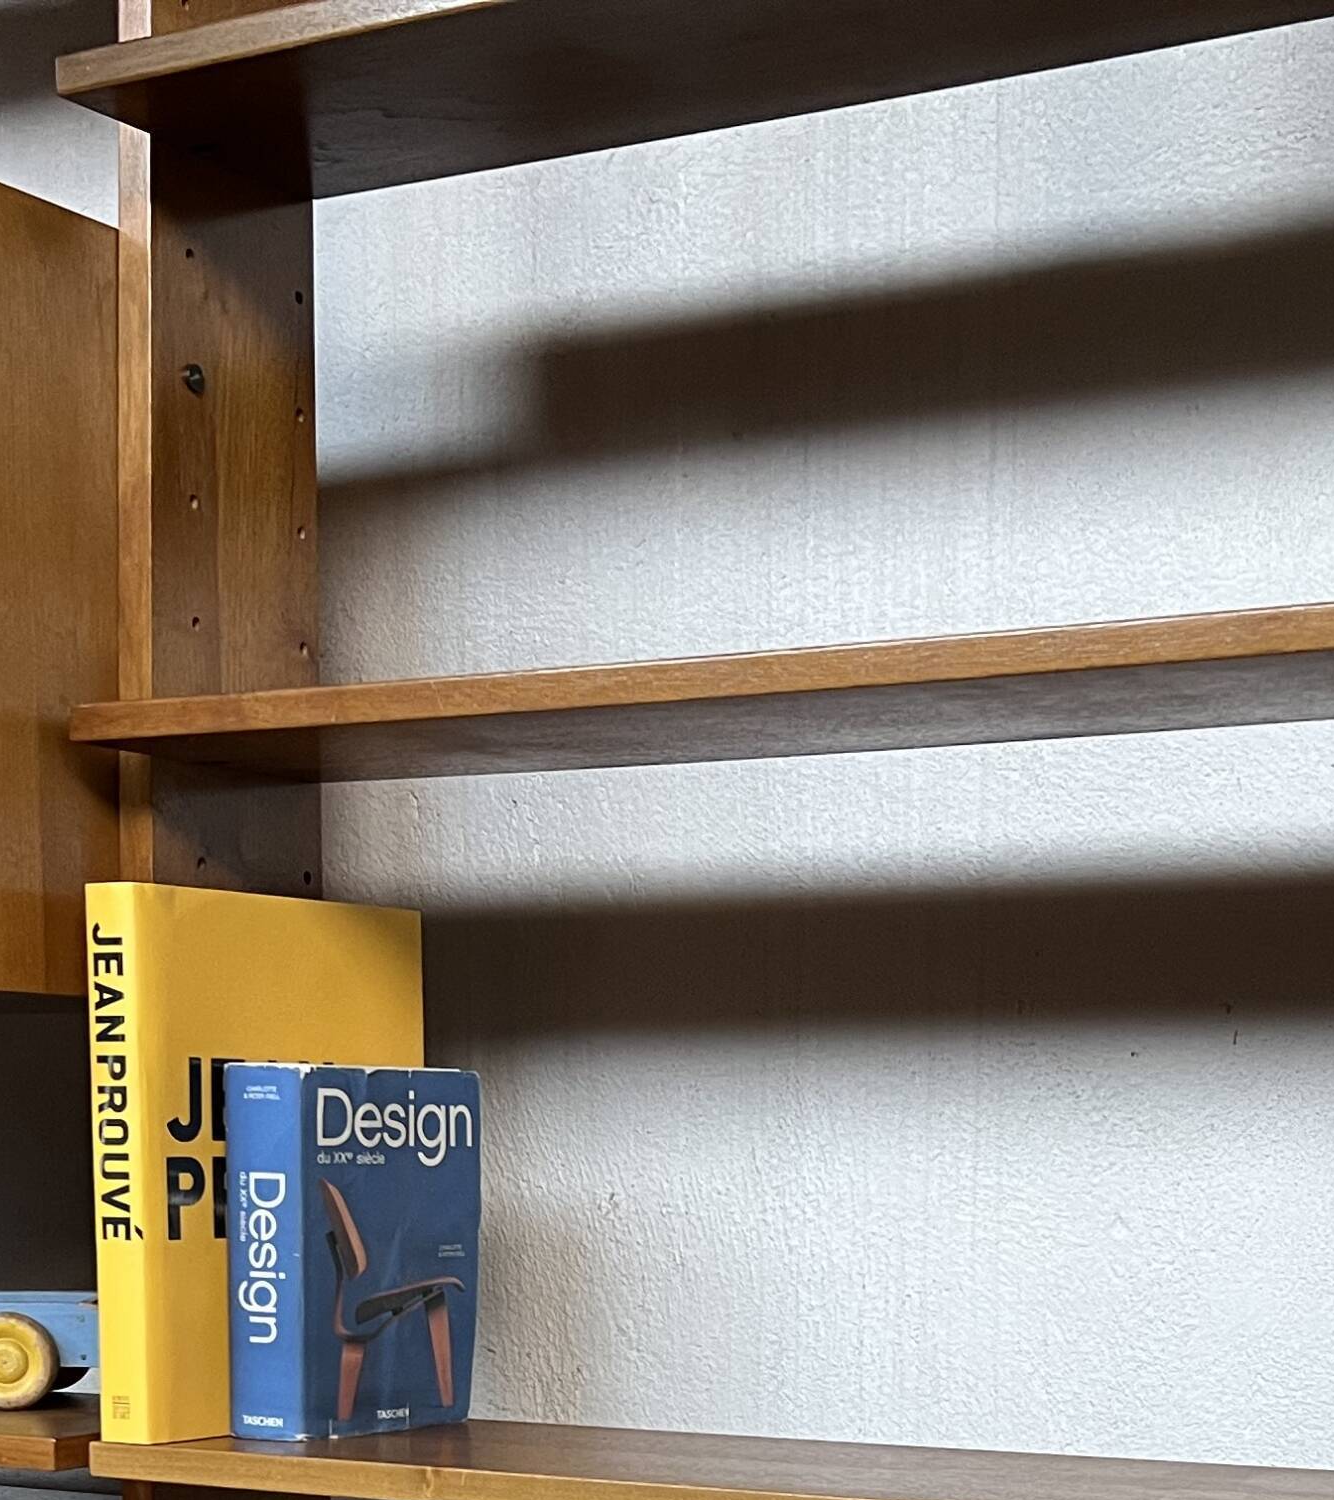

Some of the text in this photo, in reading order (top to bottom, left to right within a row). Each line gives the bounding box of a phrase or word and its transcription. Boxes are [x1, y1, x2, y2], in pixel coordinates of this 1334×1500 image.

[92, 922, 144, 1241] JEAN PROUVÉ
[317, 1087, 472, 1167] Design
[317, 1151, 331, 1164] du
[239, 1171, 248, 1186] du
[238, 1171, 286, 1343] Design
[243, 1414, 283, 1428] TASCHEN
[376, 1408, 410, 1420] TASCHEN
